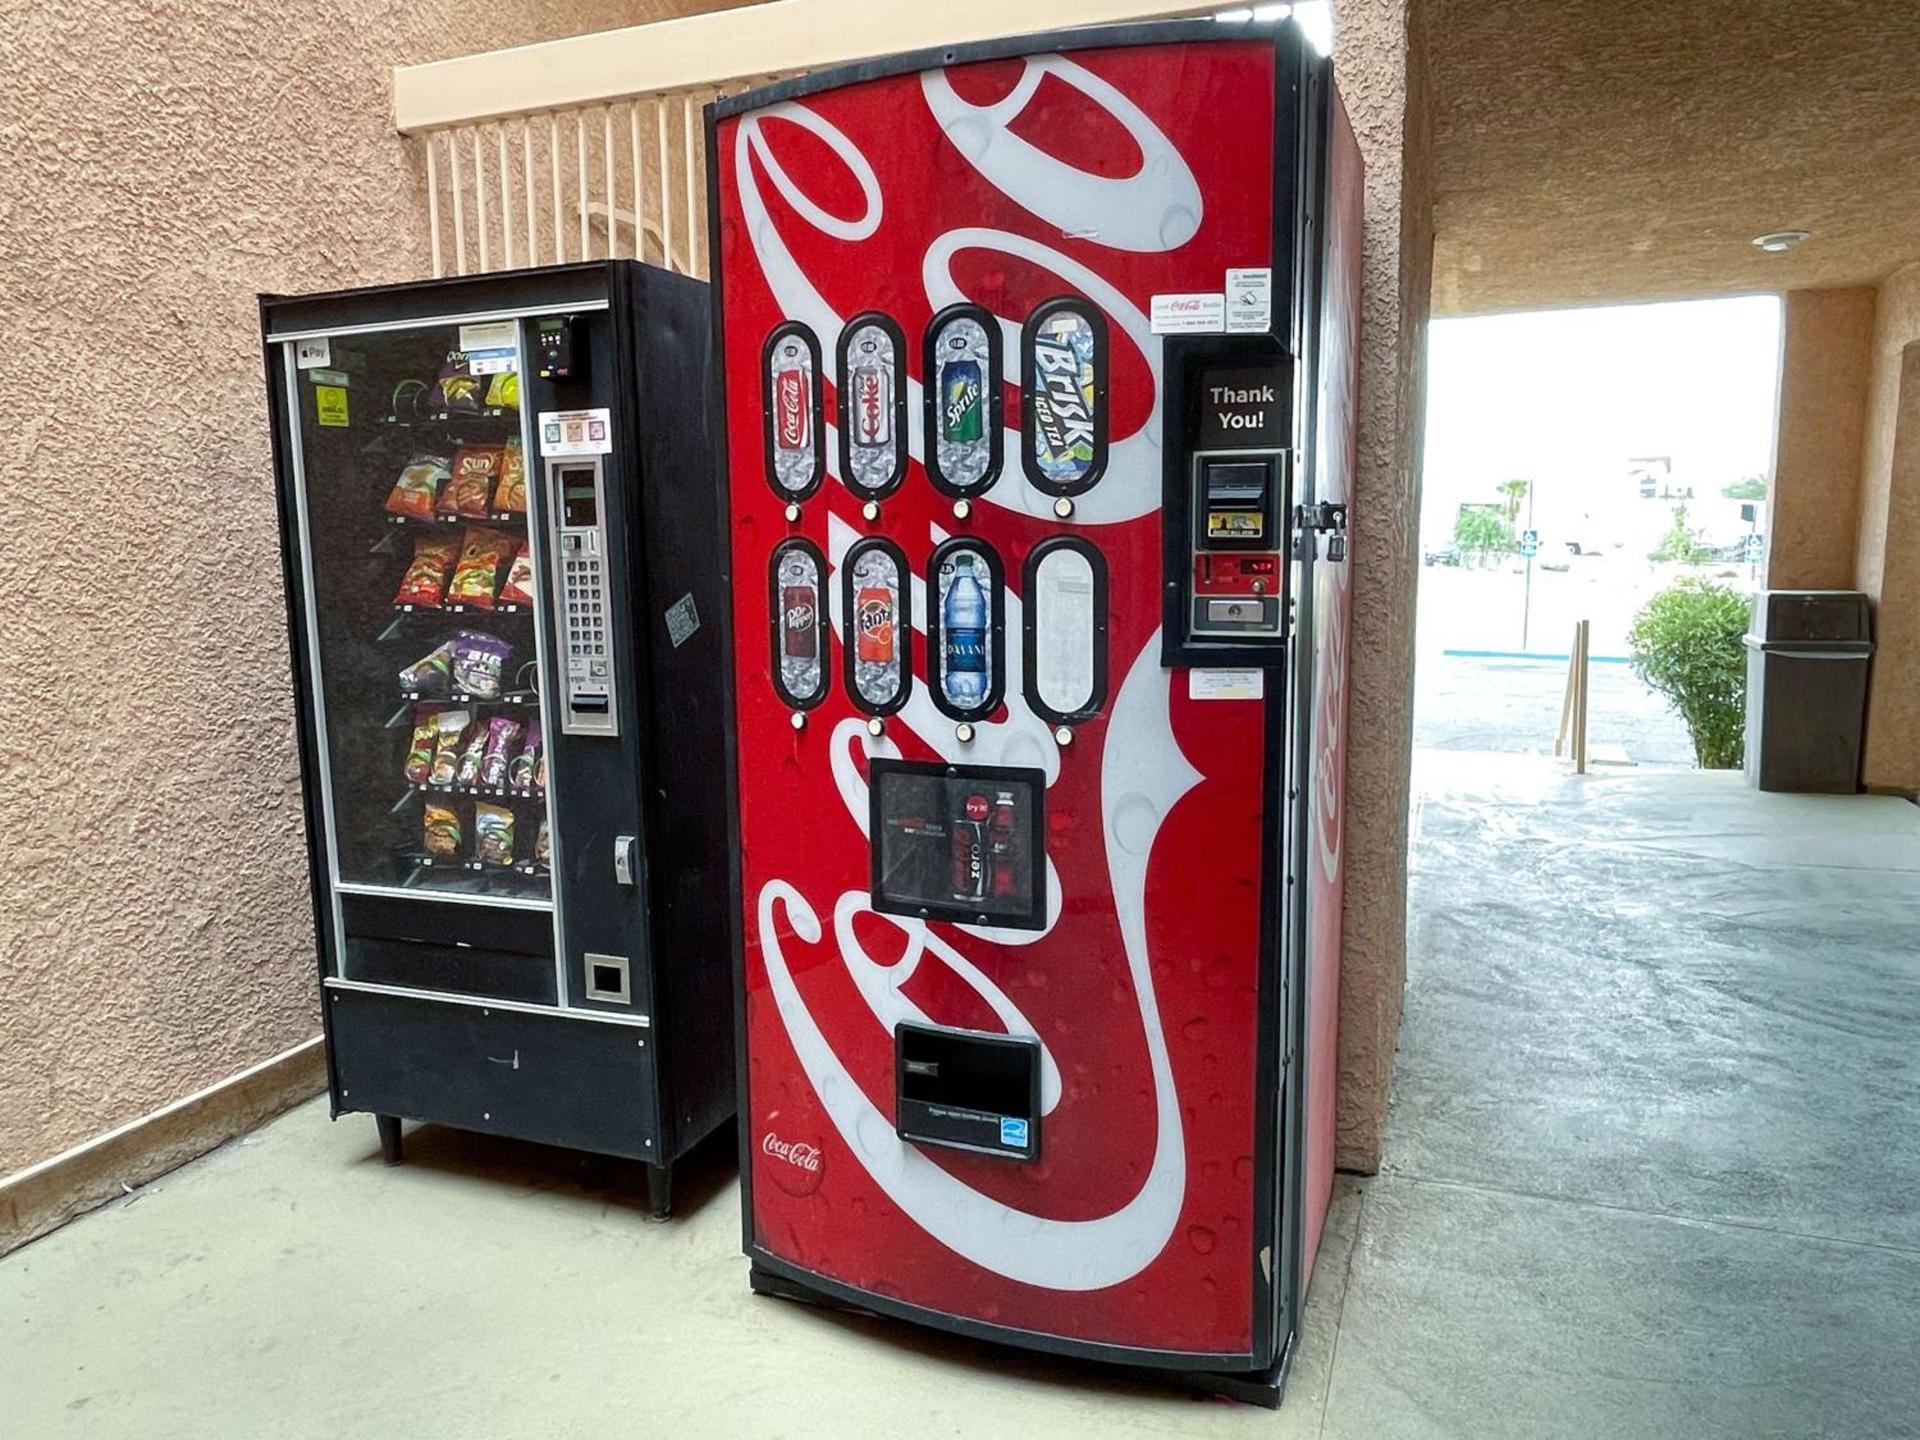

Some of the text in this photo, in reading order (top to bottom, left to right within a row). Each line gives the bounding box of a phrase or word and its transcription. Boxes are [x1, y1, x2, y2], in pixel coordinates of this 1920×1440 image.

[862, 376, 879, 437] Coke
[947, 383, 979, 428] Sprite
[1210, 385, 1274, 404] Thank
[1045, 426, 1064, 448] TEA
[1218, 411, 1264, 429] You!
[971, 844, 981, 879] zero
[763, 1132, 820, 1172] Coca-Cola
